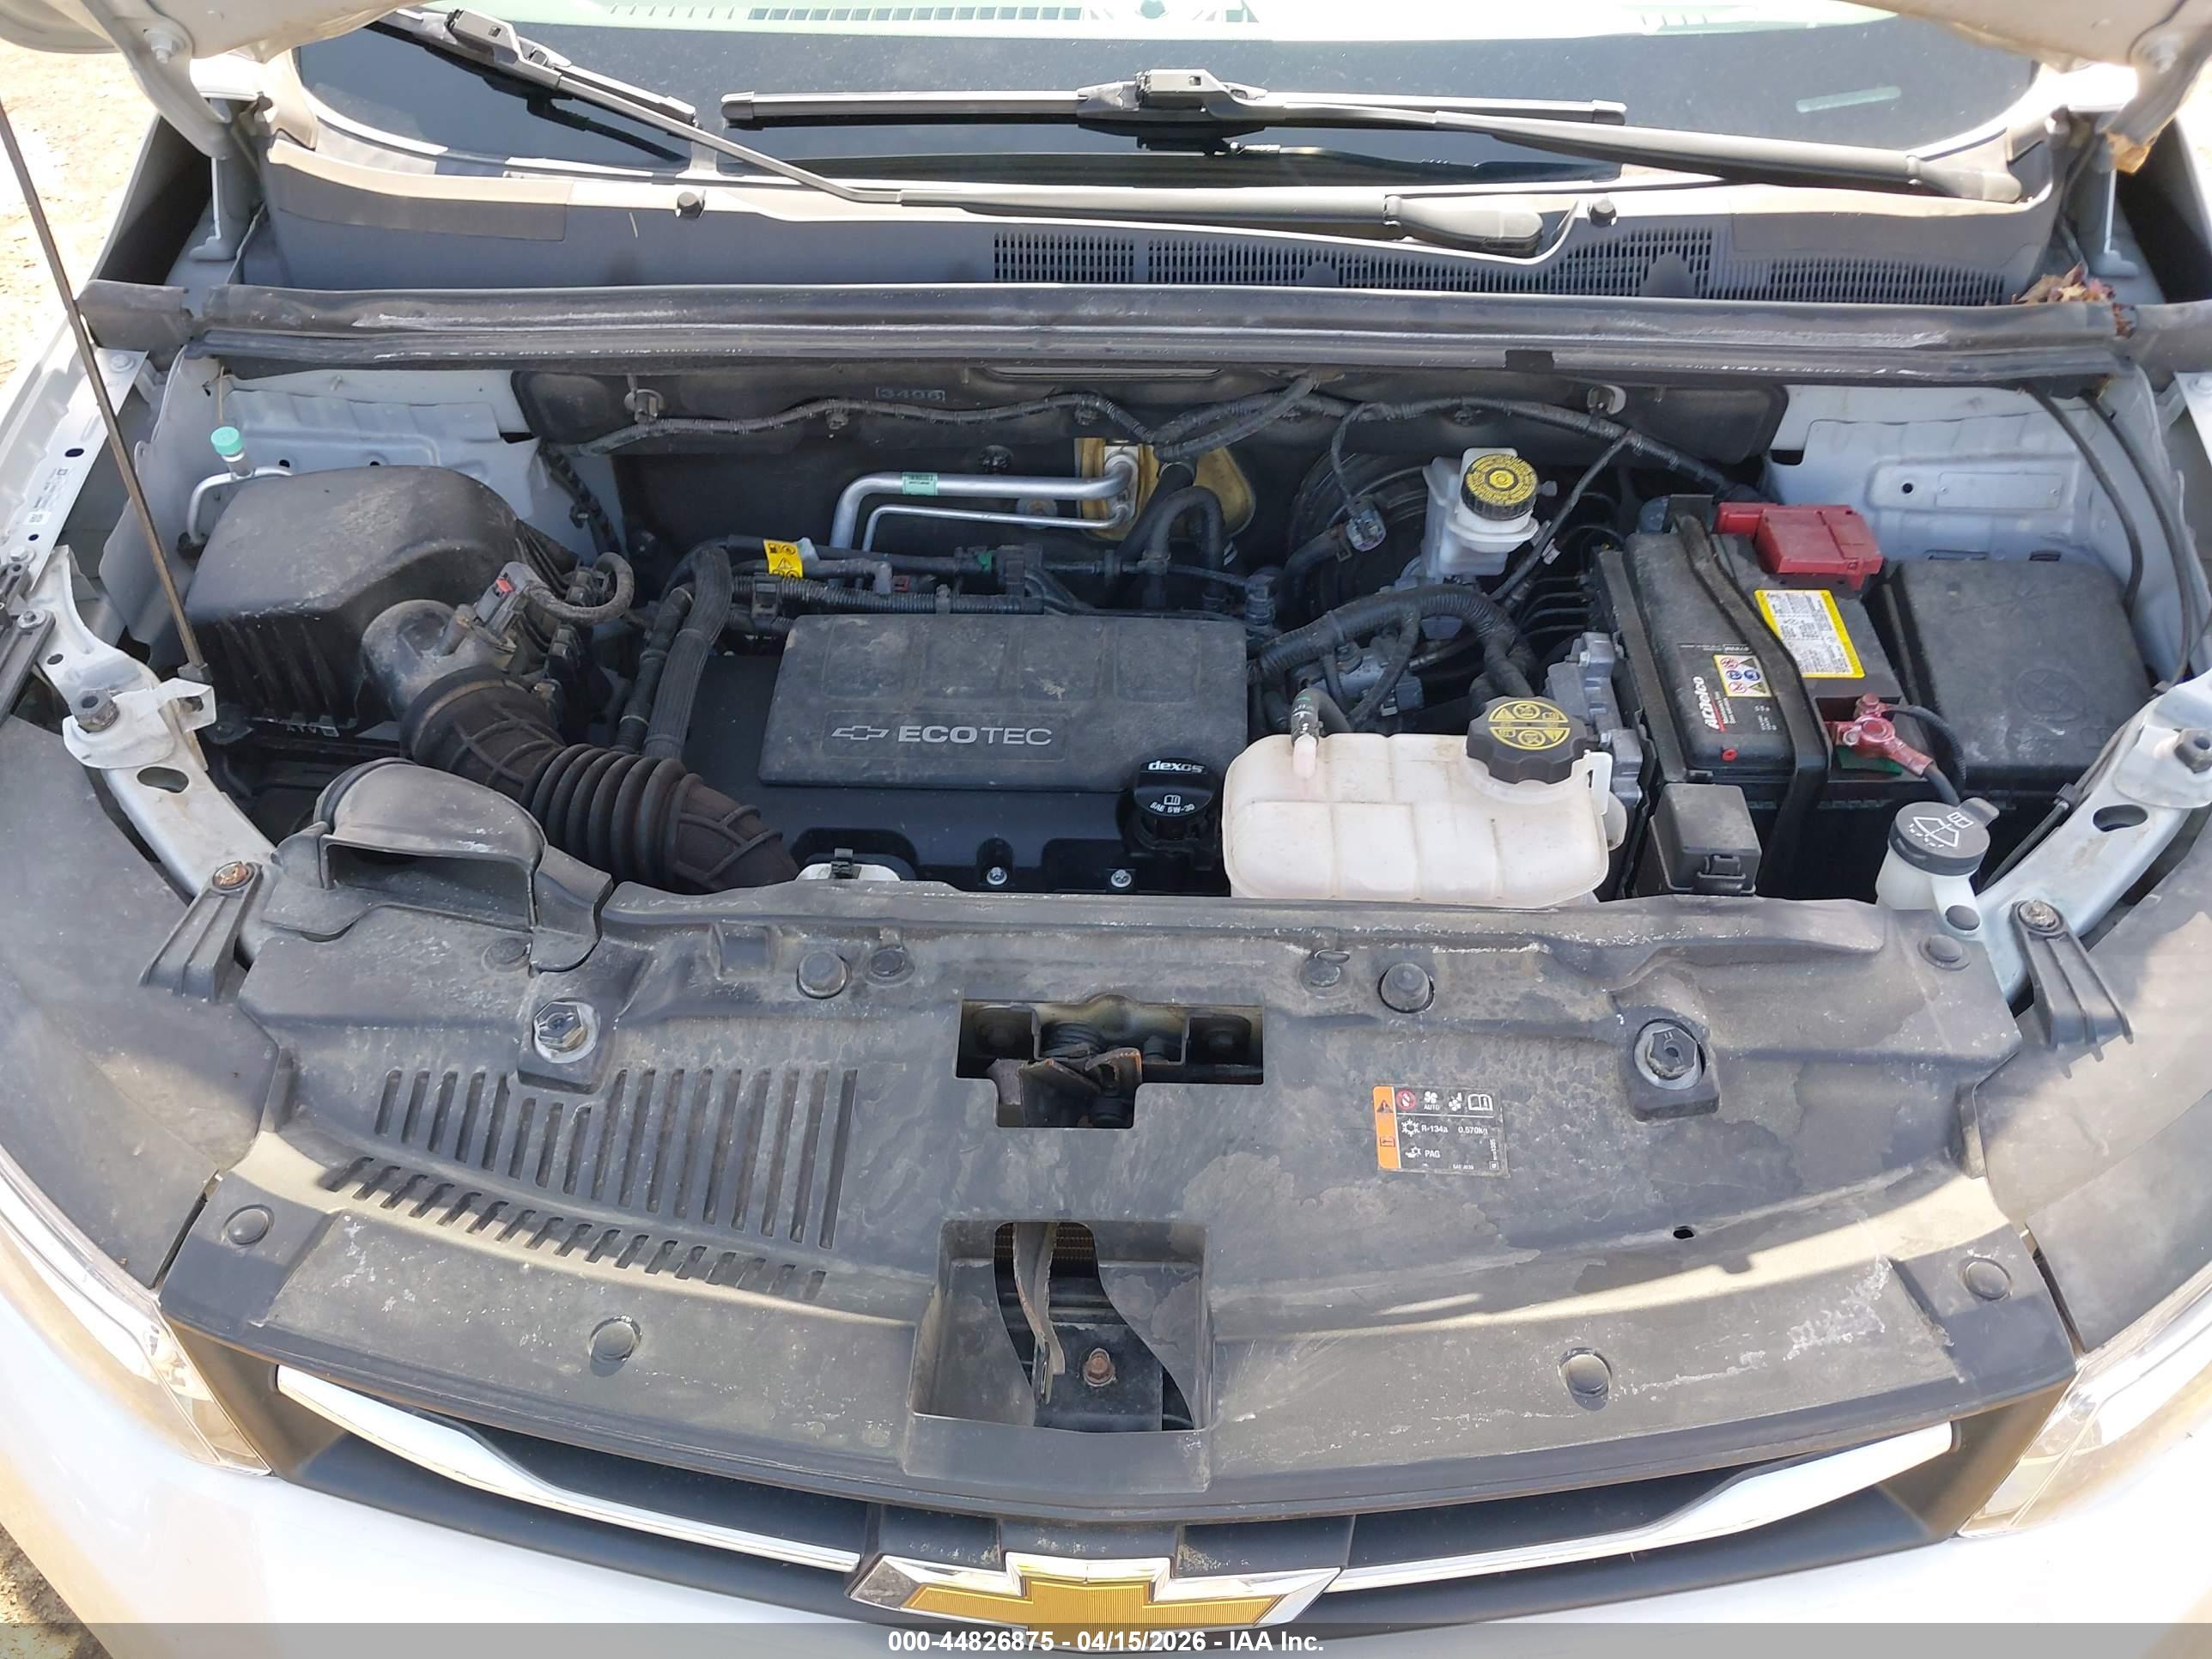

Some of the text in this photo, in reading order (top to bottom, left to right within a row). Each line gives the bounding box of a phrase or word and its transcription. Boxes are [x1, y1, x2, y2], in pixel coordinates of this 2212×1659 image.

[898, 725, 1053, 745] ECOTEC
[1148, 760, 1205, 774] dexos
[1425, 1149, 1441, 1158] PAG
